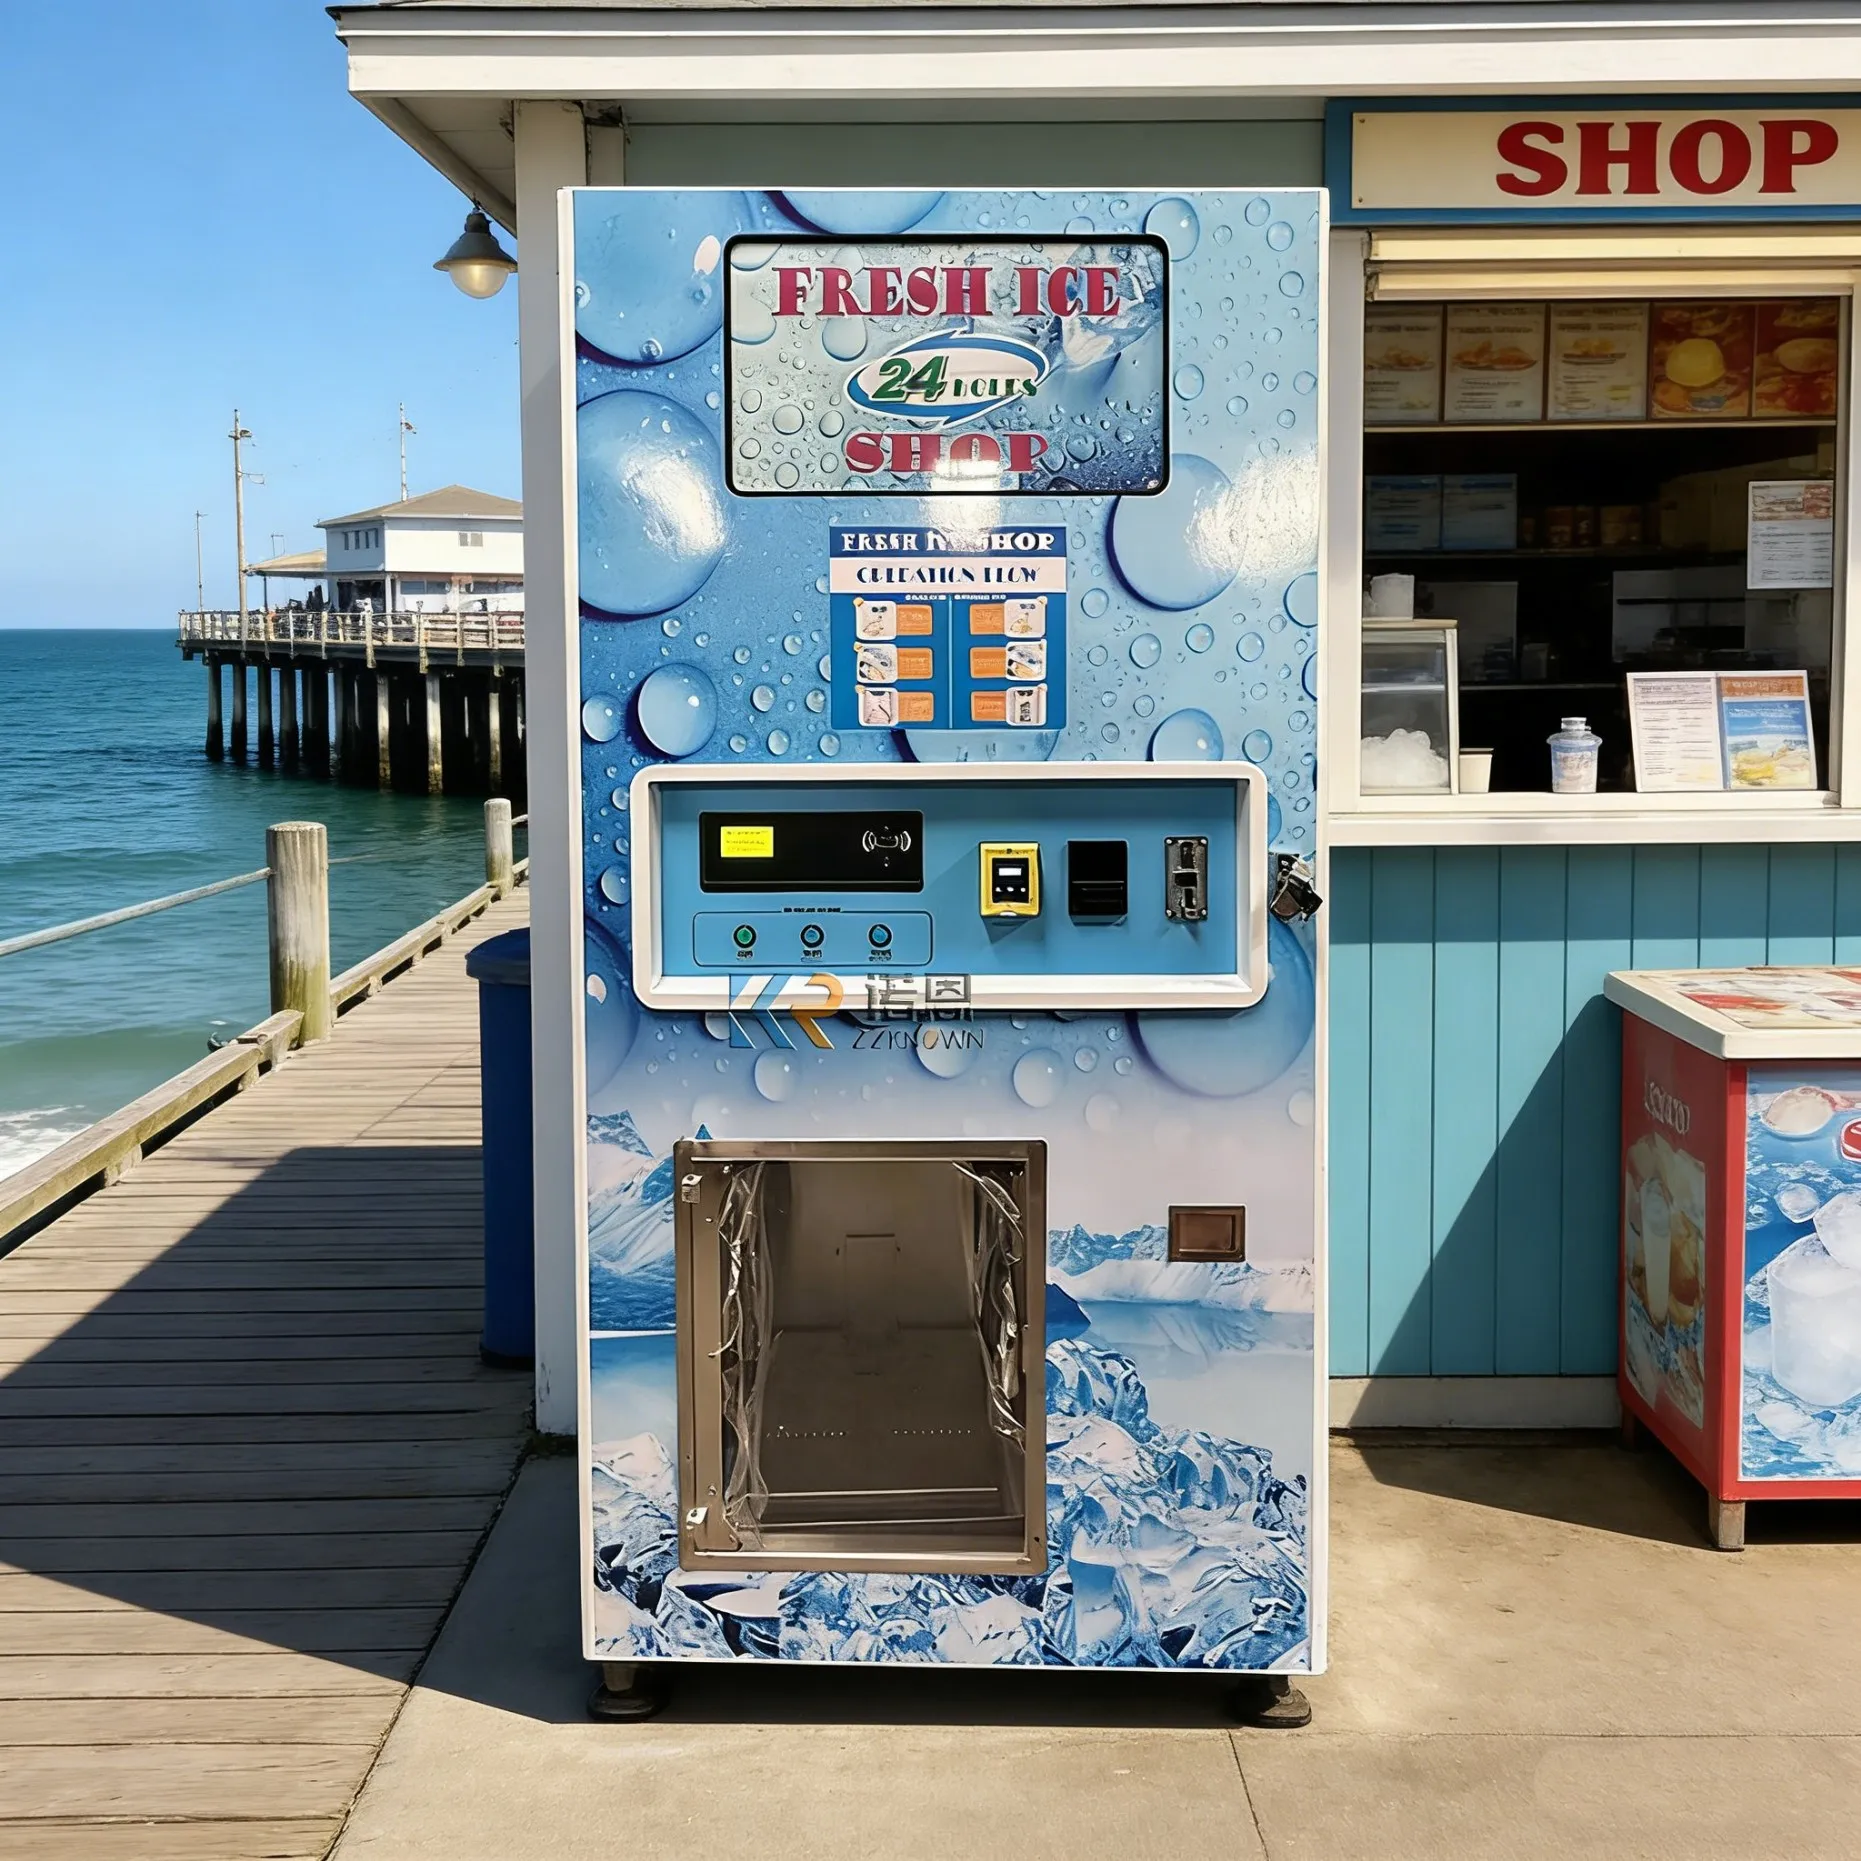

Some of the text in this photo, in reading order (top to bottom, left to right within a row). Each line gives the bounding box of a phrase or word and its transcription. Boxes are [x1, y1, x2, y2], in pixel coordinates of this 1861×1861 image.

[1495, 119, 1839, 197] SHOP
[772, 266, 1121, 317] FRESH ICE
[870, 355, 948, 403] 24
[844, 432, 1049, 474] SHOP
